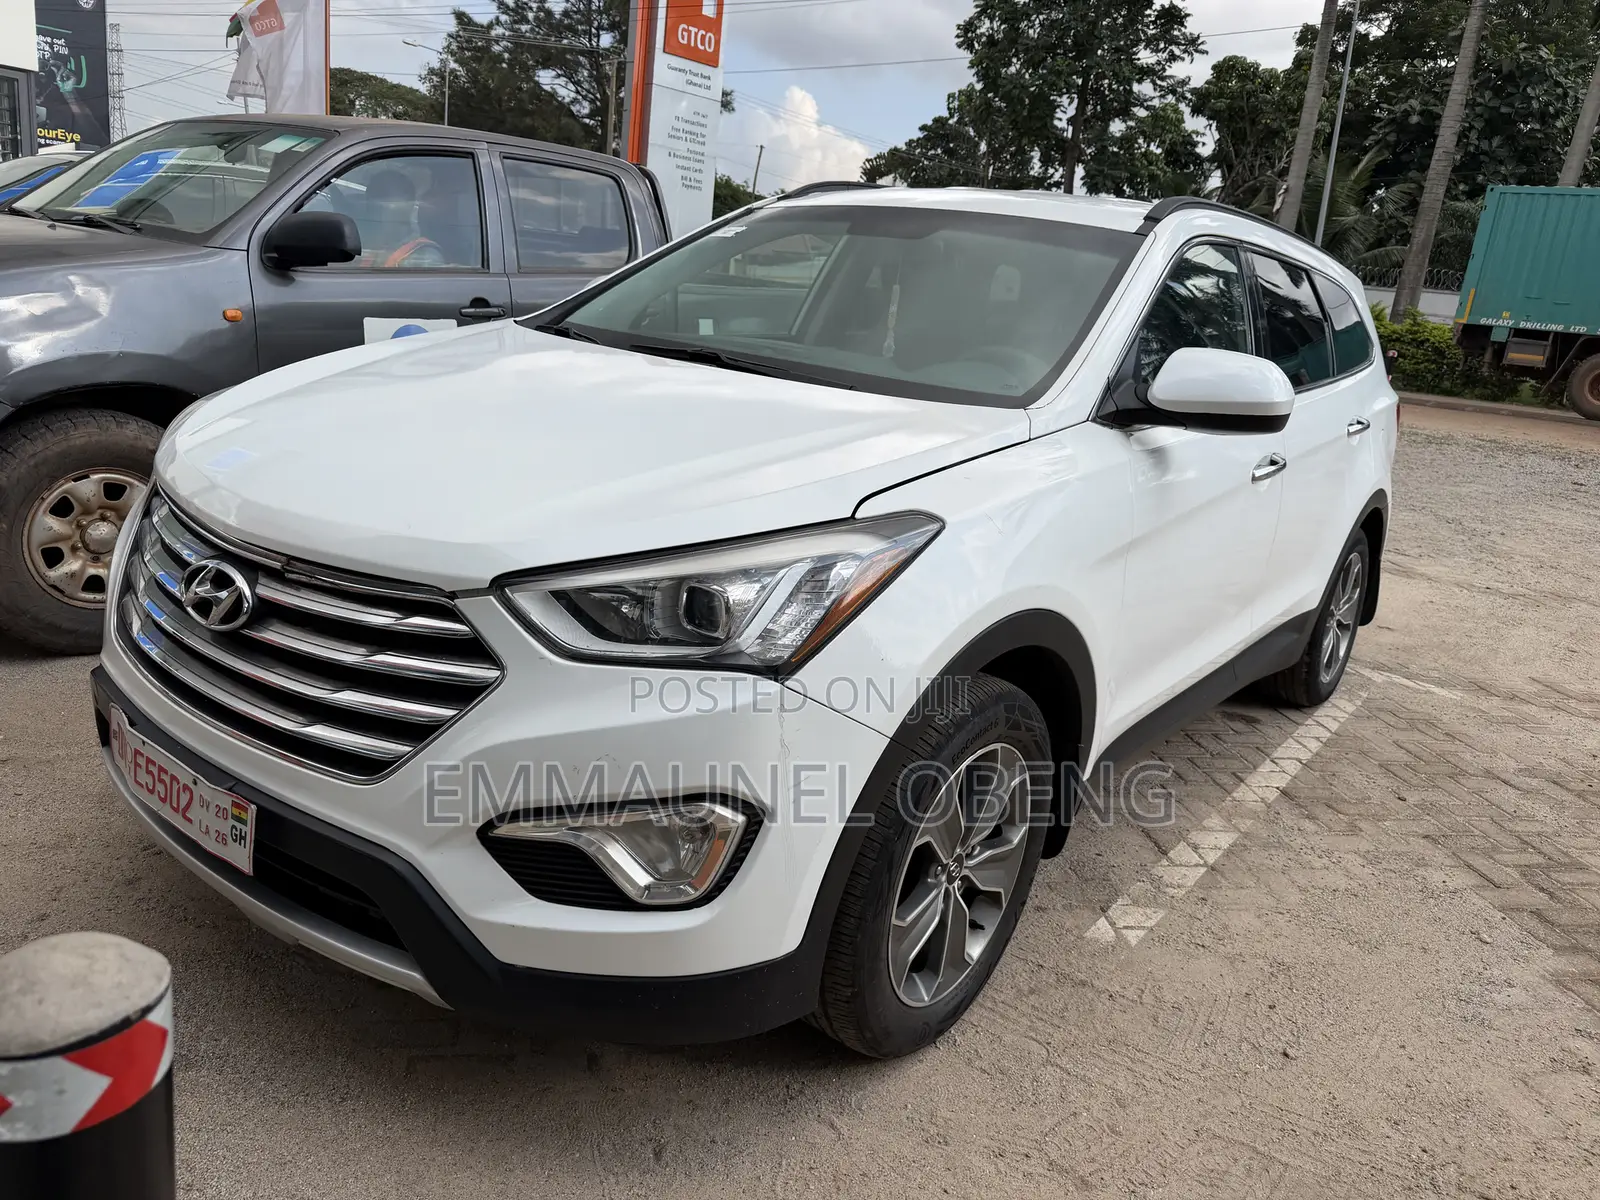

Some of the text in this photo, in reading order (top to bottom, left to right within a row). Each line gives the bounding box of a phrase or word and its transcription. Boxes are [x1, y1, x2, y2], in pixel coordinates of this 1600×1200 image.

[53, 38, 66, 46] out
[678, 24, 715, 52] GTCO
[53, 44, 69, 55] PIN
[667, 63, 712, 82] Guaranty Trust Bank
[686, 79, 712, 91] (Ghana) Ltd
[681, 117, 707, 128] Transactions
[668, 133, 683, 141] Seniors
[672, 125, 680, 133] Free
[682, 127, 699, 139] Banking
[673, 152, 691, 161] Business
[687, 147, 706, 157] Personal
[692, 166, 703, 174] Cards
[682, 182, 702, 191] Payments
[1480, 317, 1515, 327] GALAXY
[1519, 320, 1565, 331] DRILLING
[1570, 325, 1588, 333] LTD
[951, 721, 995, 765] EcoContact
[133, 747, 194, 825] E5502
[199, 793, 229, 821] DV 20
[198, 818, 228, 846] LA 26
[230, 823, 247, 850] GH
